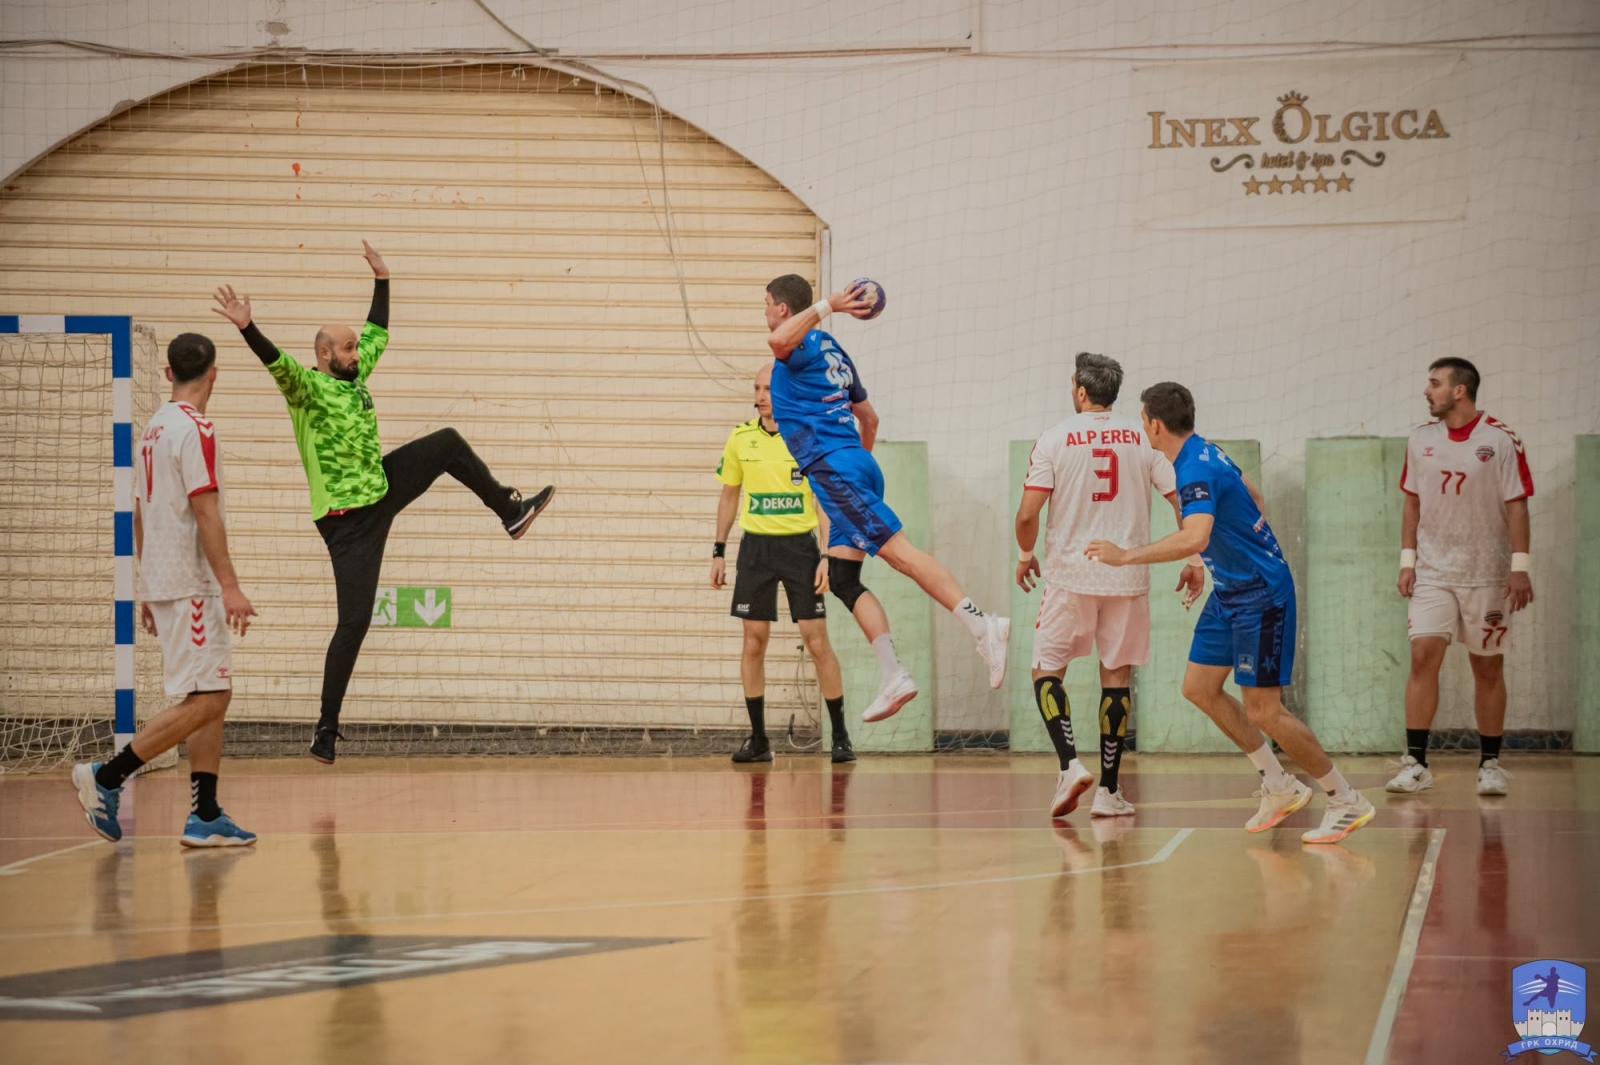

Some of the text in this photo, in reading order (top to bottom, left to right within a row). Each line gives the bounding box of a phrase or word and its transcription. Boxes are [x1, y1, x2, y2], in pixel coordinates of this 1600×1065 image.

[1147, 111, 1261, 149] INEX
[1260, 150, 1335, 172] hotel & spa
[1066, 429, 1141, 447] ALP EREN
[1092, 448, 1119, 502] 3
[1440, 469, 1467, 495] 77
[762, 497, 802, 510] DEKRA
[1481, 626, 1508, 650] 77
